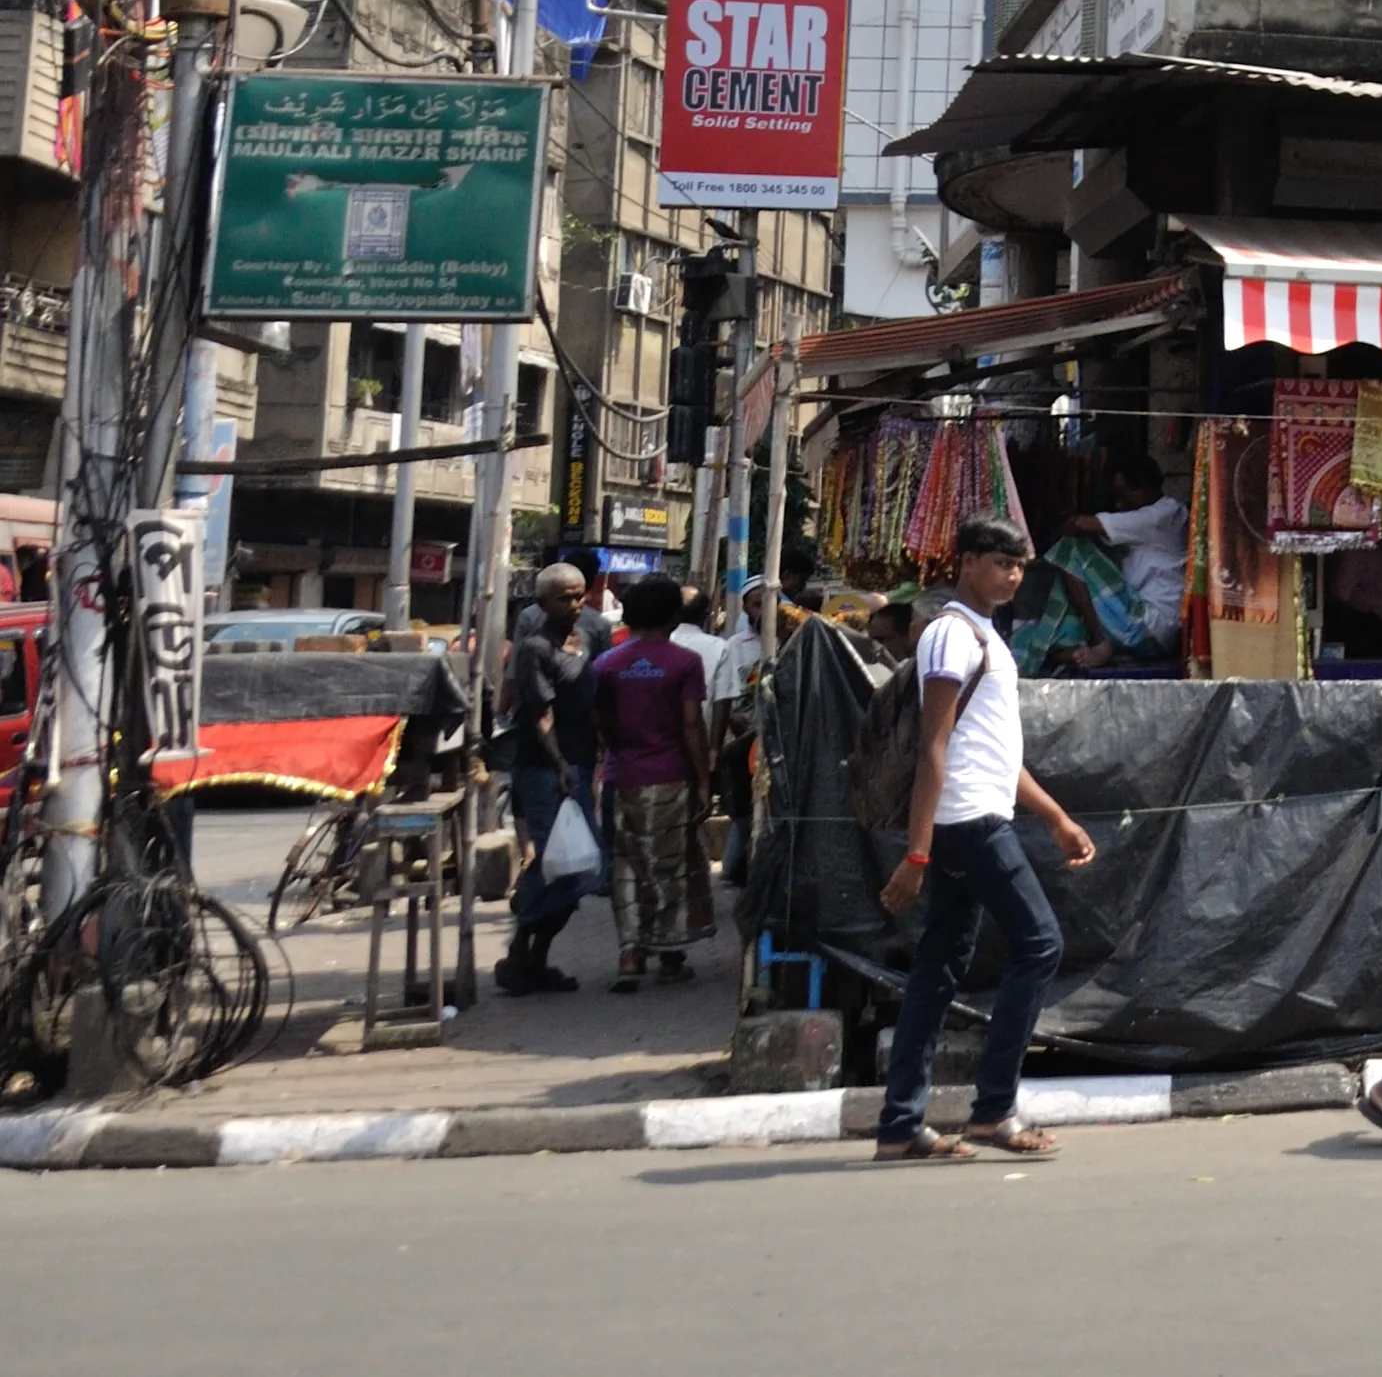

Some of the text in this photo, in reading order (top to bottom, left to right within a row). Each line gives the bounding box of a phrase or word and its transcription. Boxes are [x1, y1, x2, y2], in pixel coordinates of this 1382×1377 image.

[682, 67, 825, 116] CEMENT
[692, 114, 812, 134] Solid Setting
[233, 142, 528, 161] MAULAALI MAZAR SHARIF
[671, 180, 826, 197] Toll Free 1800 345 345 00
[291, 291, 343, 308] Sudip
[611, 552, 647, 570] NOKIA
[619, 667, 665, 680] adidas
